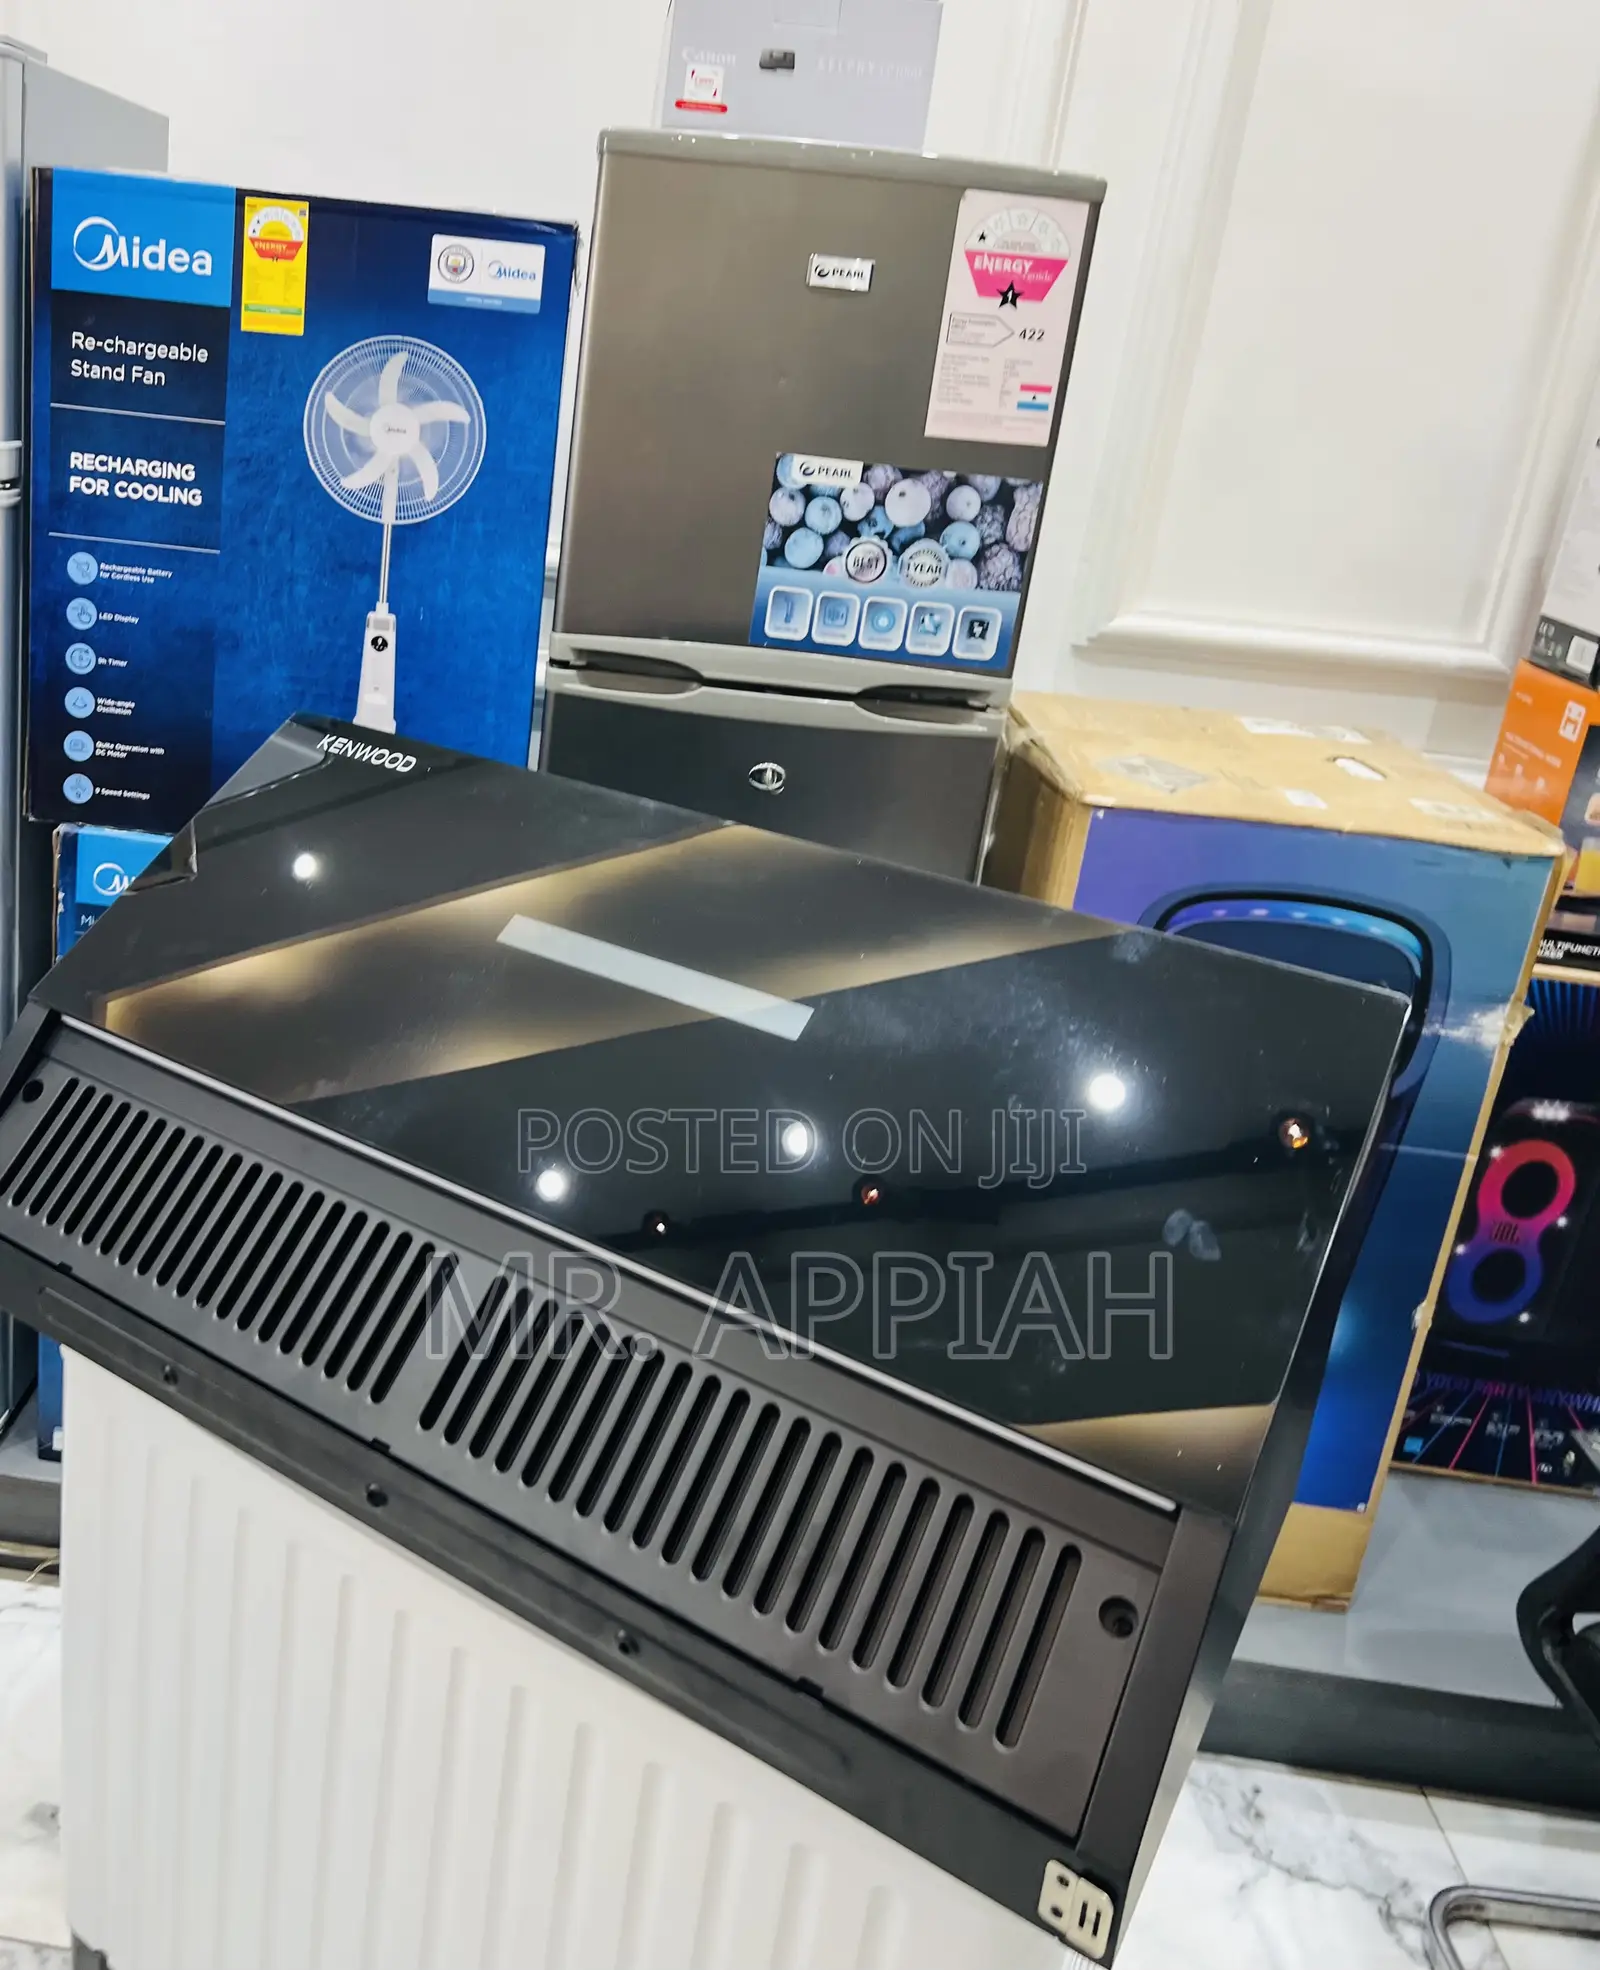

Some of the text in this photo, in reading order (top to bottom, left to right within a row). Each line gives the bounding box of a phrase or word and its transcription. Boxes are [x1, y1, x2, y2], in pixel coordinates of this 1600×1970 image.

[73, 215, 213, 277] Midea
[487, 259, 537, 282] Midea
[974, 252, 1033, 275] ENERGY
[1018, 327, 1045, 342] 422
[71, 331, 209, 363] Re-chargeable
[70, 358, 166, 387] Stand Fan
[69, 451, 196, 482] RECHARGING
[69, 475, 203, 507] FOR COOLING
[100, 562, 173, 579] Rechargeable Battery
[111, 572, 141, 583] Cordless
[141, 576, 155, 584] Use
[98, 612, 139, 625] LED Display
[108, 658, 129, 668] Timer
[96, 697, 136, 709] Wide-angle
[96, 704, 132, 716] Oscillation
[106, 750, 128, 759] Motor
[115, 743, 149, 754] Operation
[149, 747, 165, 756] with
[316, 733, 417, 773] KENWOOD
[101, 787, 123, 798] Speed
[123, 790, 150, 801] Settings
